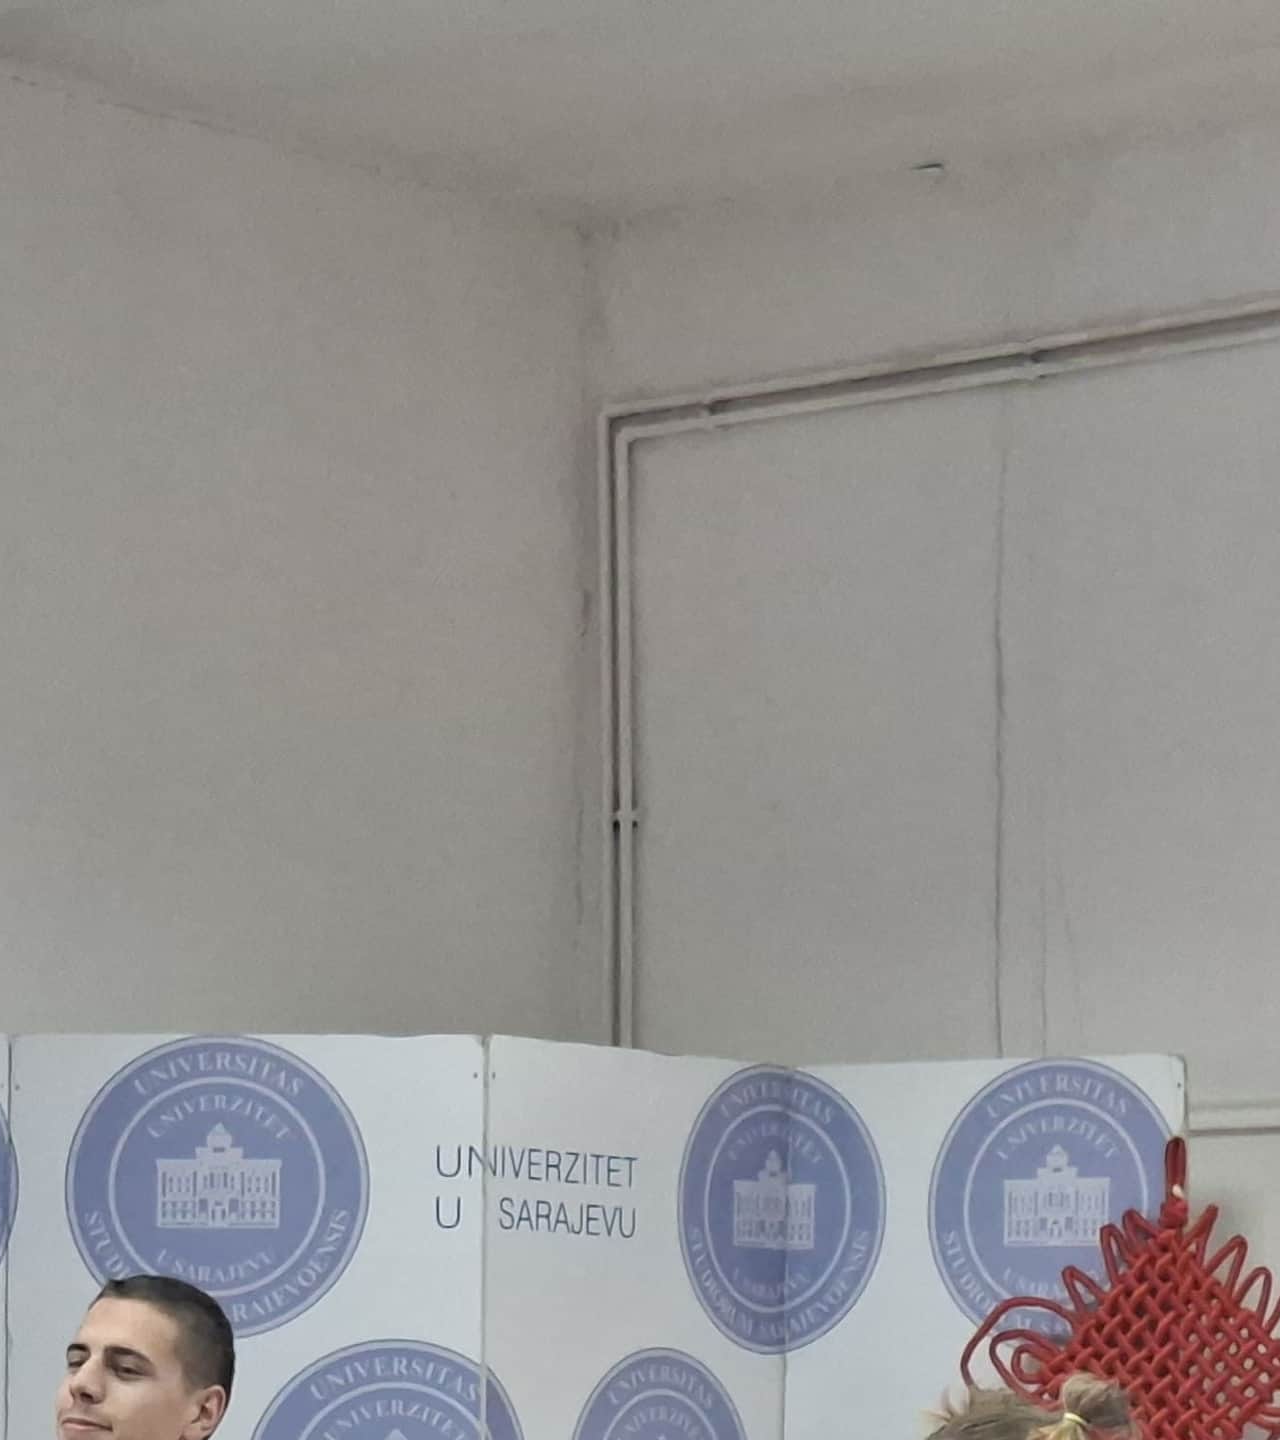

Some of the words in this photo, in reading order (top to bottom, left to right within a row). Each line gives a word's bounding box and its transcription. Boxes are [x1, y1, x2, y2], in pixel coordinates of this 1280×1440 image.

[132, 1050, 305, 1096] UNIVERSITAS
[986, 1072, 1128, 1119] UNIVERSITAS
[146, 1093, 290, 1140] UNIVERZITET
[435, 1144, 638, 1188] UNIVERZITET
[435, 1196, 461, 1229] U
[498, 1196, 636, 1239] SARAJEVU
[309, 1355, 479, 1402] UNIVERSITAS
